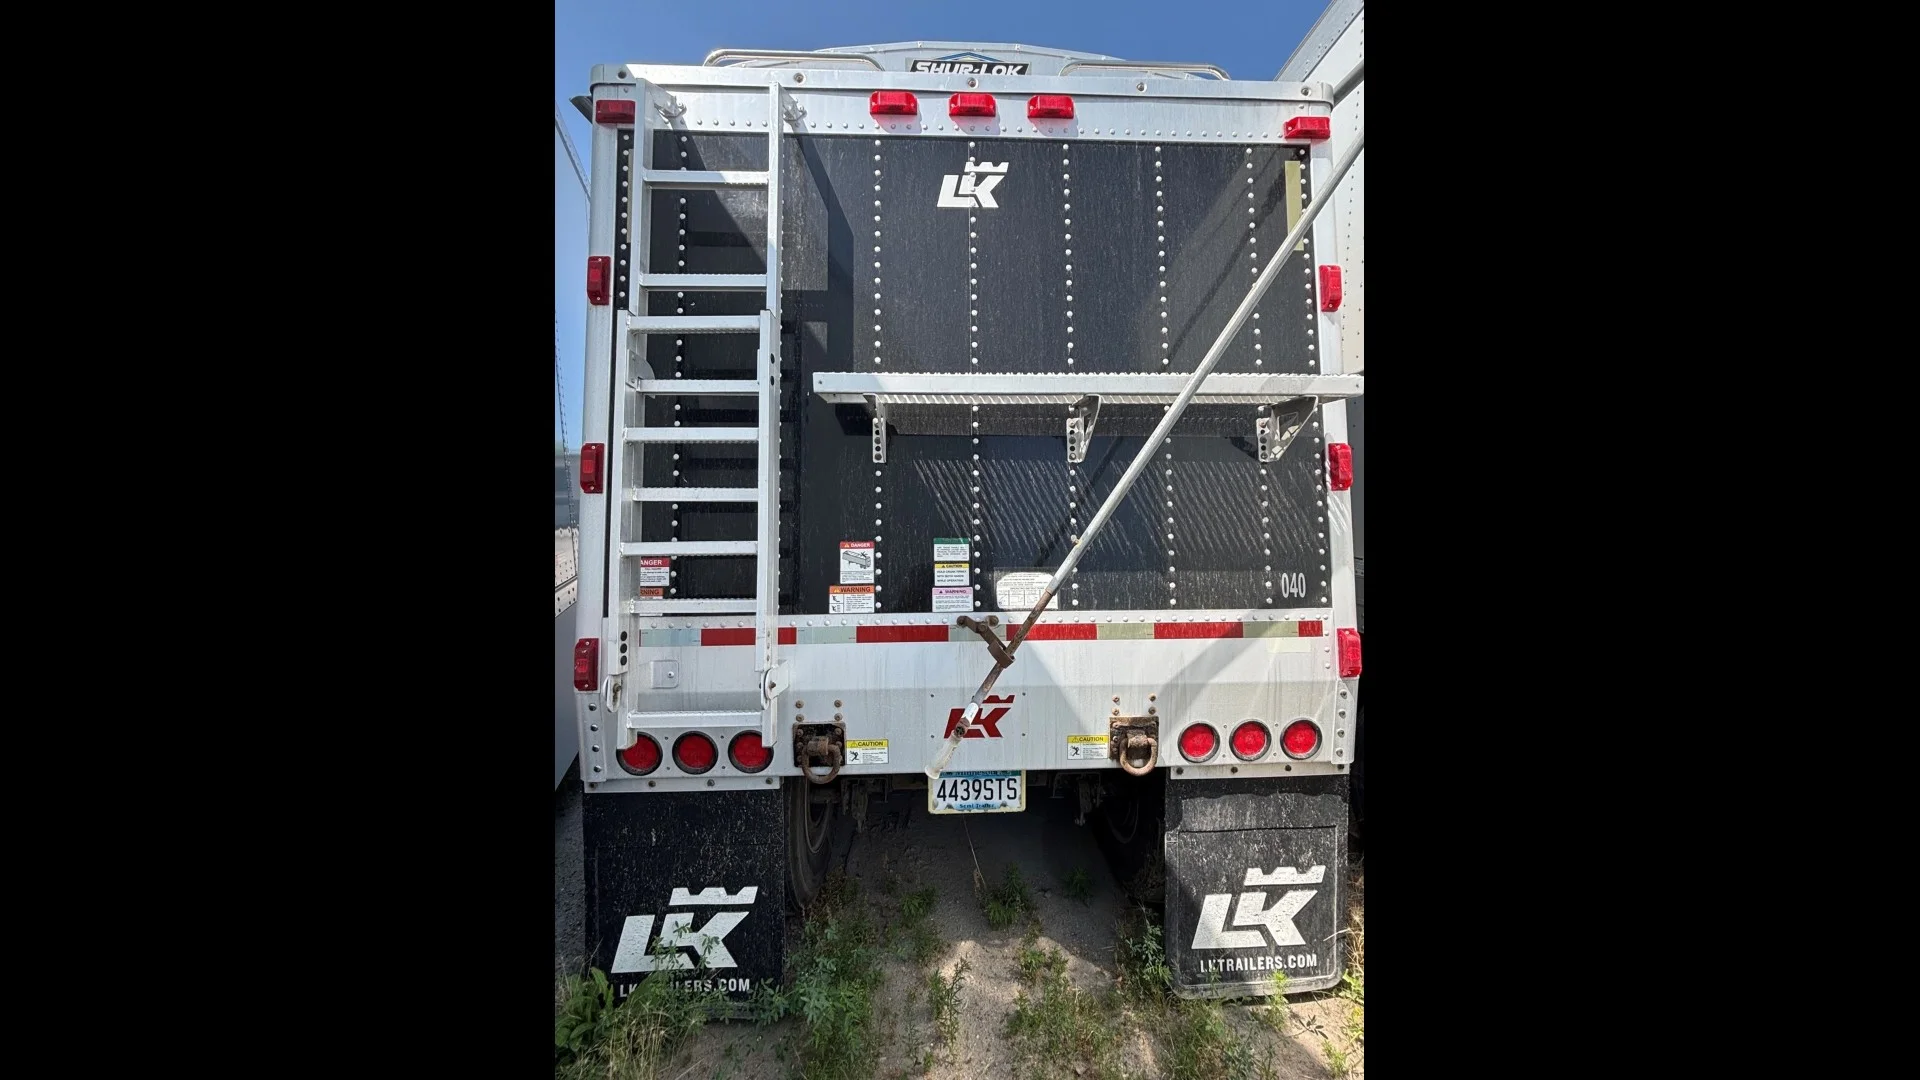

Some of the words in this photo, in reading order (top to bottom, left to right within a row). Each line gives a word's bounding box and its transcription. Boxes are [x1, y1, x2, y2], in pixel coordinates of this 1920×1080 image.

[916, 61, 1023, 76] SHUR-LOK
[937, 174, 1005, 208] LK
[1281, 572, 1307, 598] 040
[937, 778, 1017, 801] 4439STS
[1191, 889, 1318, 949] LK
[611, 911, 749, 973] LK
